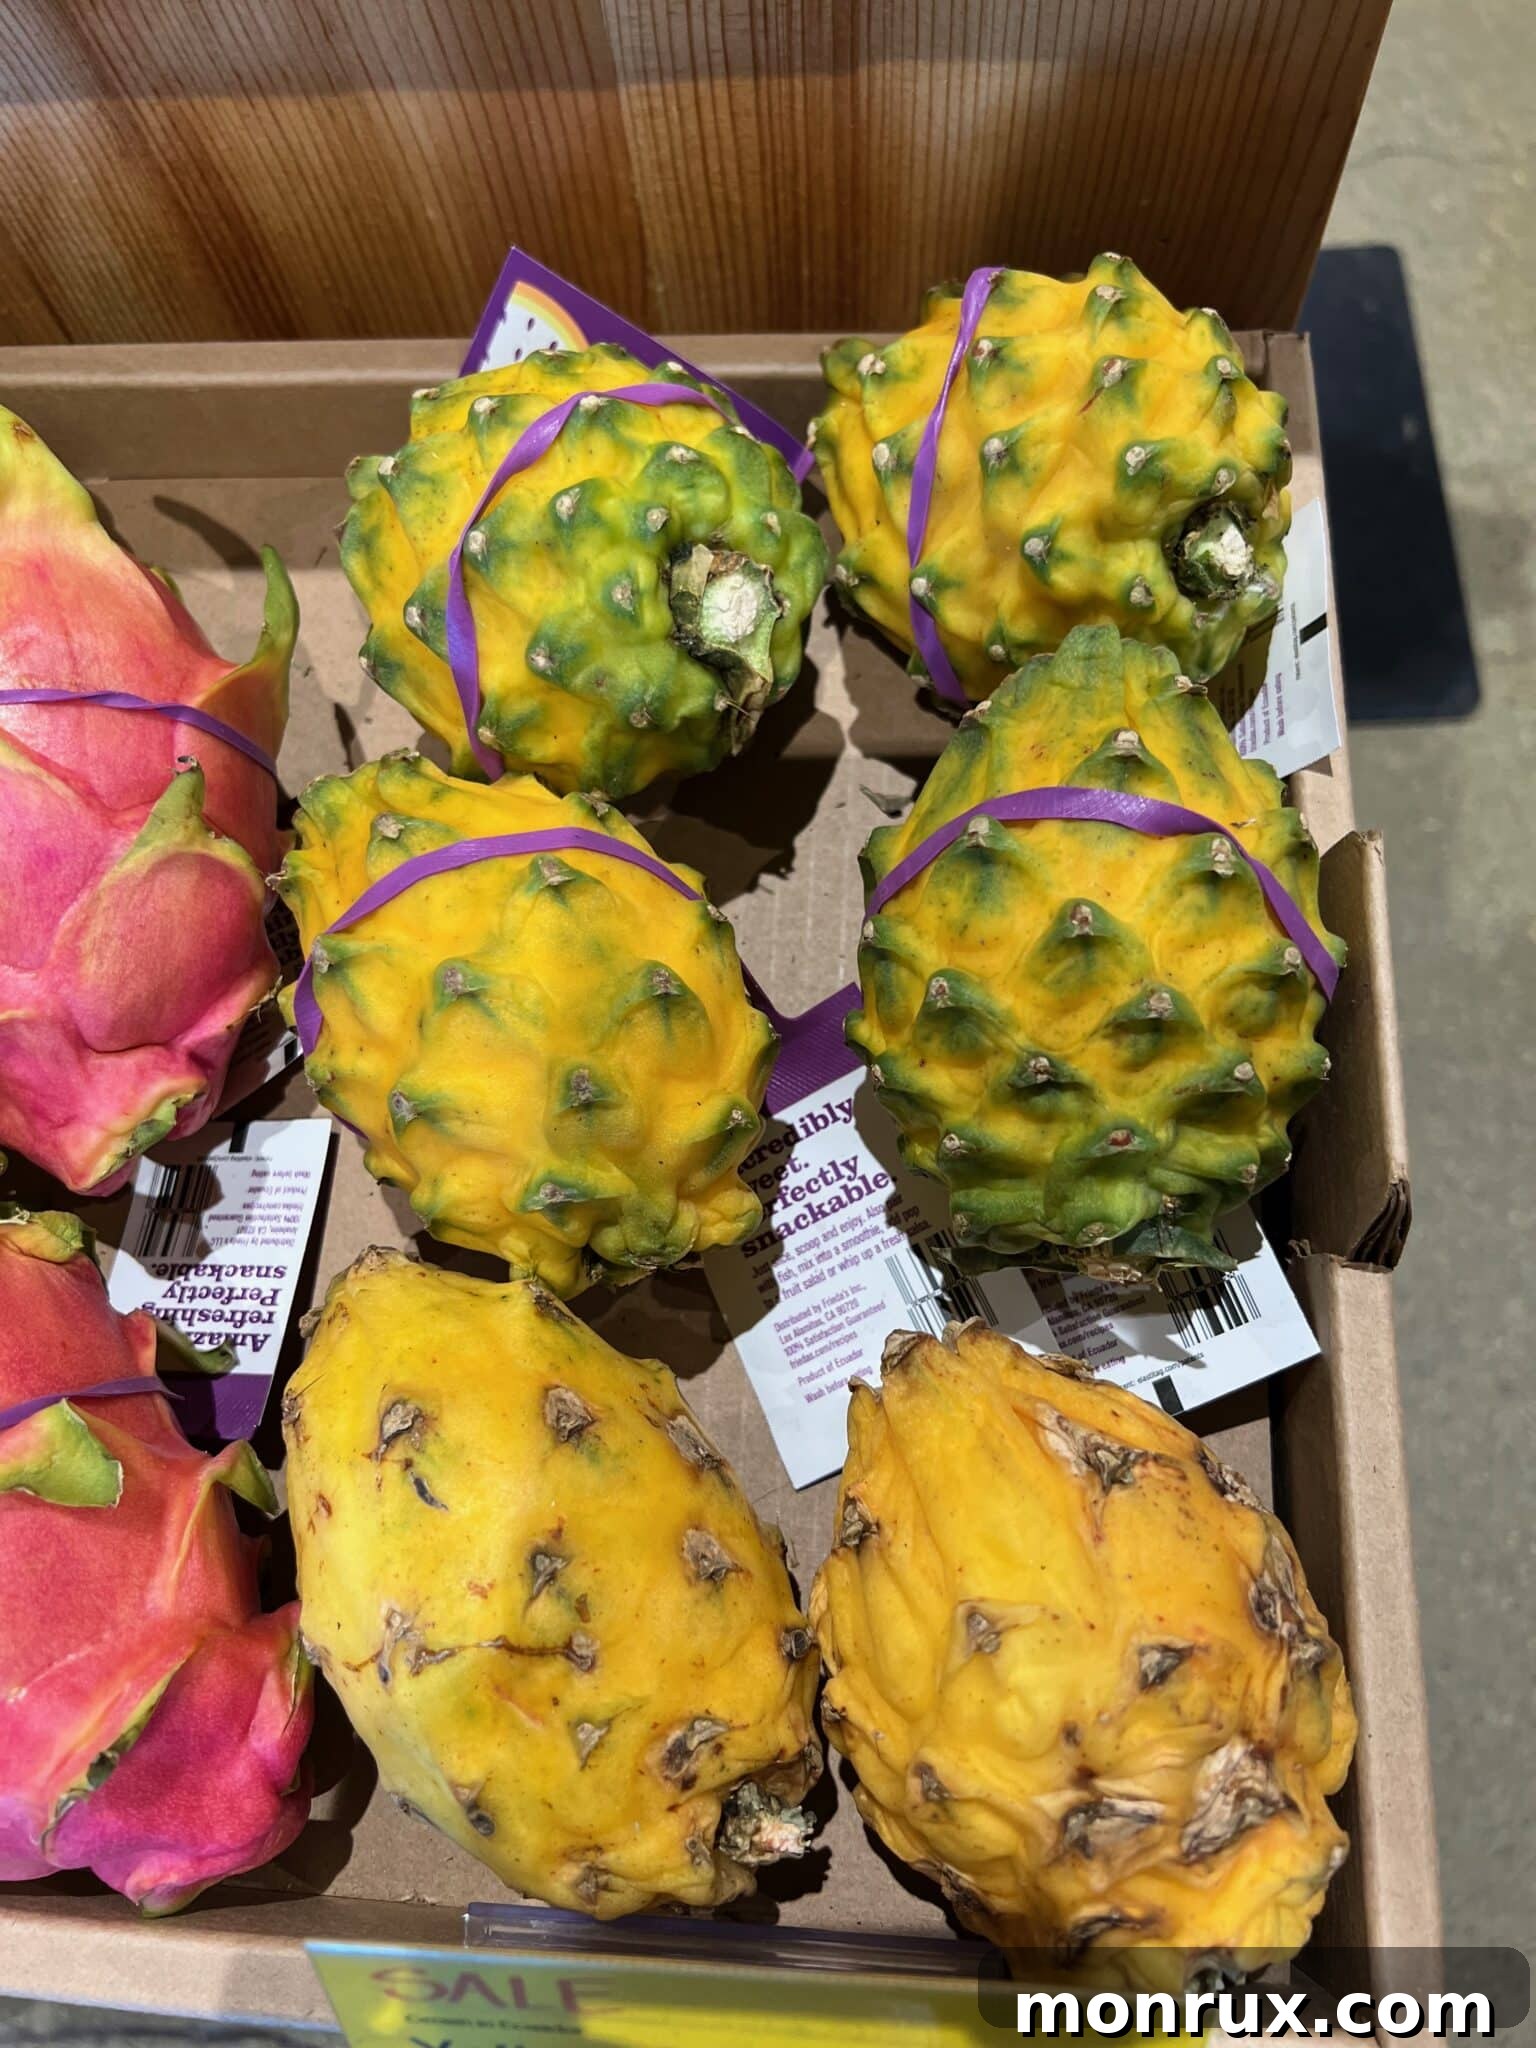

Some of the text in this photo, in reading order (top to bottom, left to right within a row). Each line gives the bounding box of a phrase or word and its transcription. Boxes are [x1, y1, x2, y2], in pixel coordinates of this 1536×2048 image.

[737, 1098, 853, 1174] credibly
[747, 1154, 809, 1192] eet.
[763, 1155, 859, 1218] rfectly
[742, 1172, 897, 1259] snackable.
[794, 1236, 821, 1255] scoop
[821, 1227, 837, 1240] and
[839, 1214, 865, 1234] enjoy.
[777, 1267, 796, 1282] fish,
[797, 1258, 813, 1271] mix
[814, 1248, 832, 1263] into
[840, 1223, 883, 1250] smoothie,
[781, 1283, 800, 1298] fruit
[802, 1271, 825, 1288] salad
[827, 1267, 837, 1276] or
[837, 1254, 860, 1271] whip
[861, 1249, 873, 1260] up
[881, 1230, 905, 1248] fresh
[151, 1263, 288, 1282] snackable.
[162, 1281, 283, 1306] Perfectly
[812, 1303, 821, 1313] by
[821, 1290, 849, 1307] Frieda's
[803, 1322, 845, 1346] Satisfaction
[845, 1301, 886, 1325] Guaranteed
[824, 1309, 835, 1320] CA
[789, 1331, 857, 1367] friedas.com/recipes
[1087, 1339, 1117, 1355] Ecuador
[797, 1348, 863, 1385] Product of Ecuador
[804, 1388, 825, 1402] Wash
[370, 1966, 624, 2014] SALE
